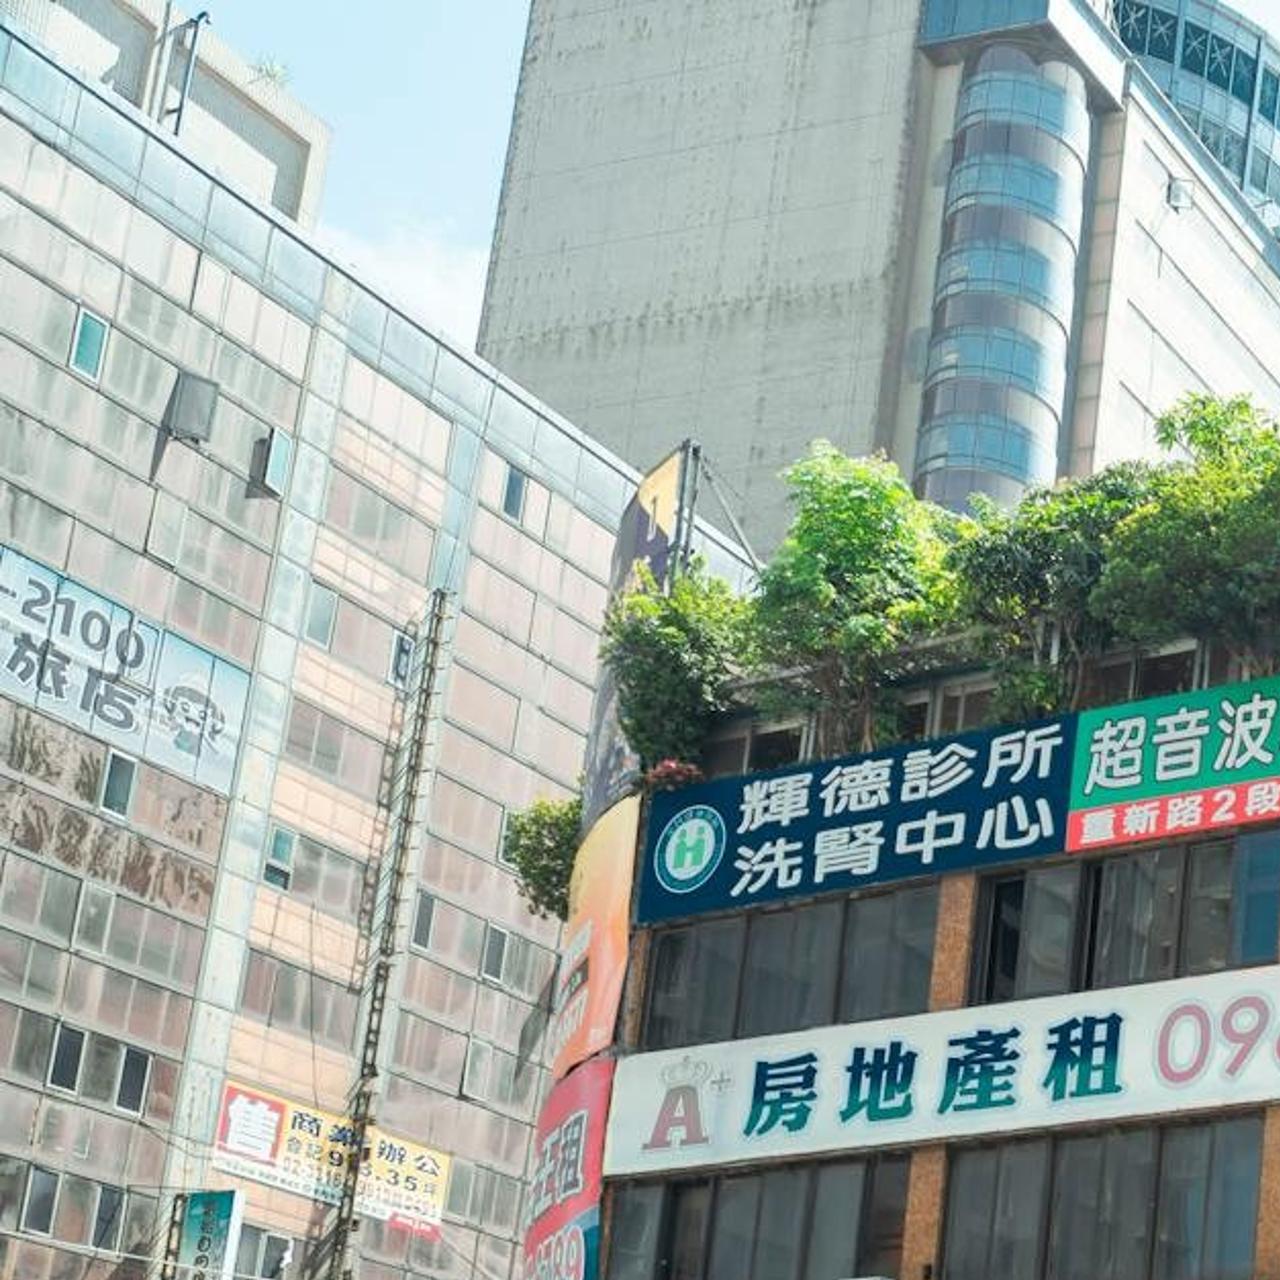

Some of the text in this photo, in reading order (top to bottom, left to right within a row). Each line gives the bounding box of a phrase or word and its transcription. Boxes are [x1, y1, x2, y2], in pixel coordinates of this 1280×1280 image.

[6, 632, 137, 730] 旅店
[737, 723, 1063, 835] 輝德診所
[729, 795, 1054, 897] 洗腎中心
[743, 1011, 1125, 1138] 房地產租
